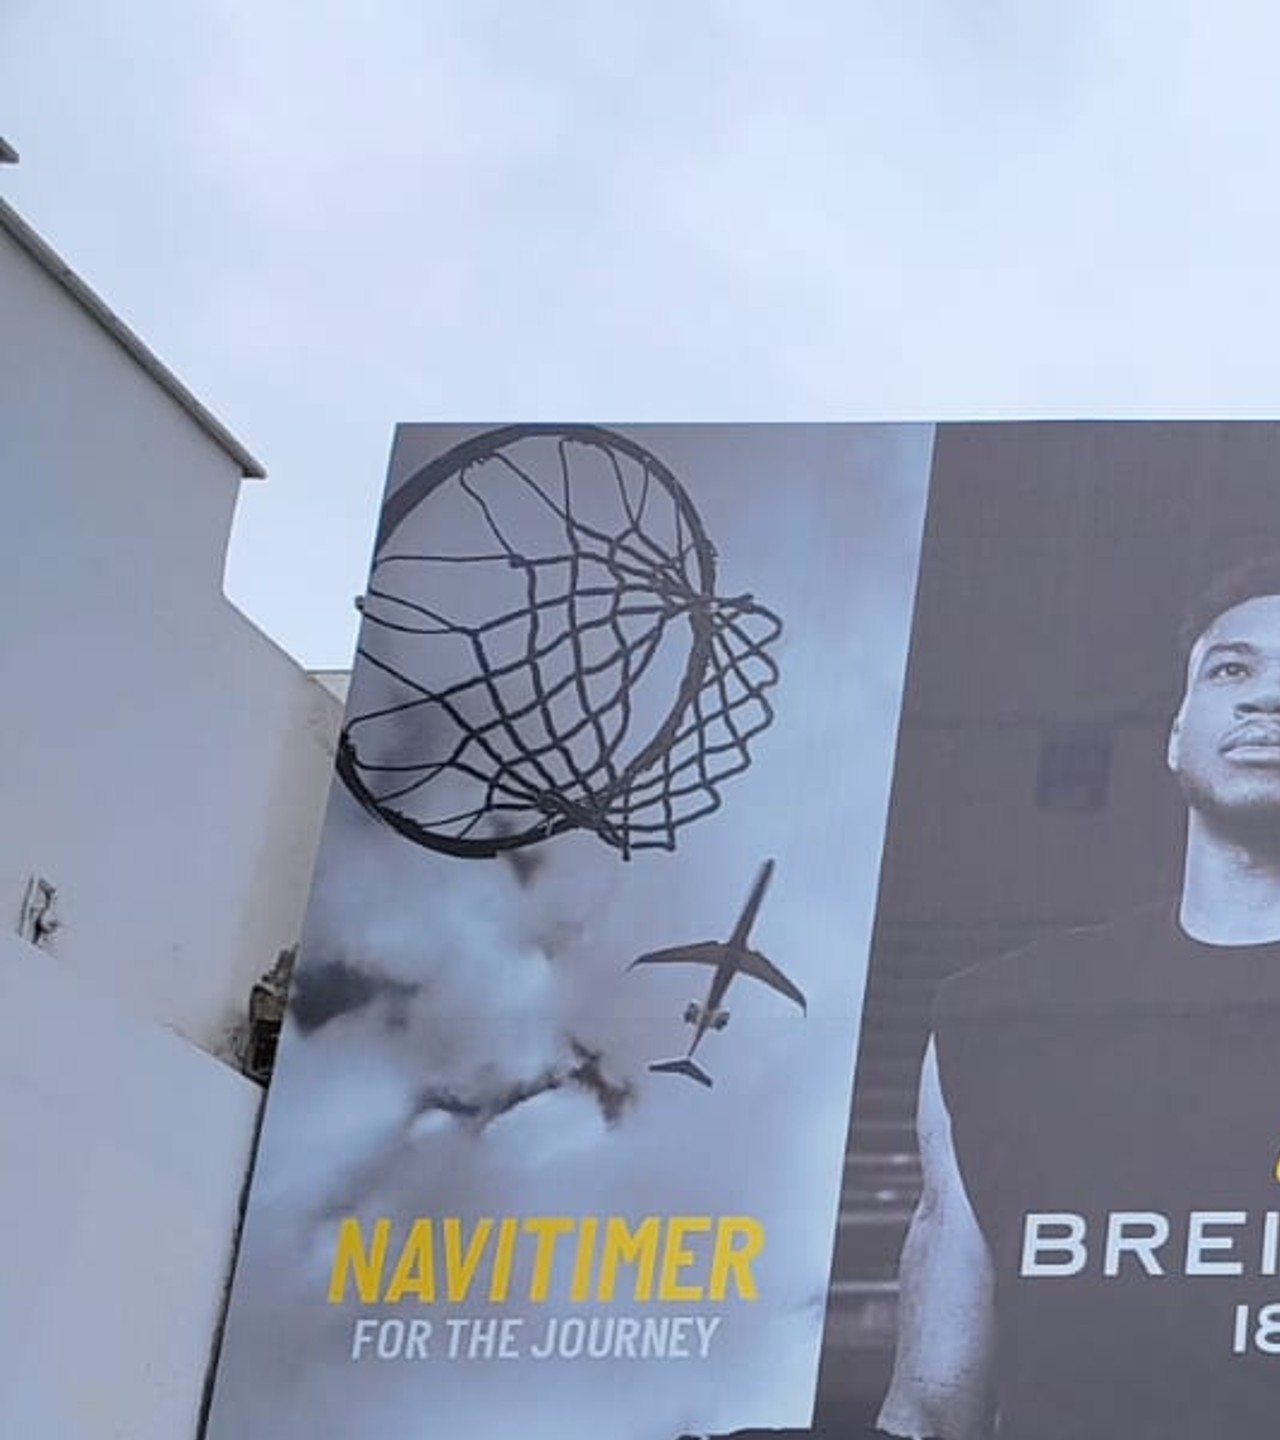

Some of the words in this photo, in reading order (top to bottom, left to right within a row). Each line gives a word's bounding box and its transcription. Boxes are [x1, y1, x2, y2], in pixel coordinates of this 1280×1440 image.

[328, 1217, 766, 1304] NAVITIMER
[351, 1319, 431, 1360] FOR
[446, 1318, 523, 1360] THE
[531, 1316, 721, 1360] JOURNEY
